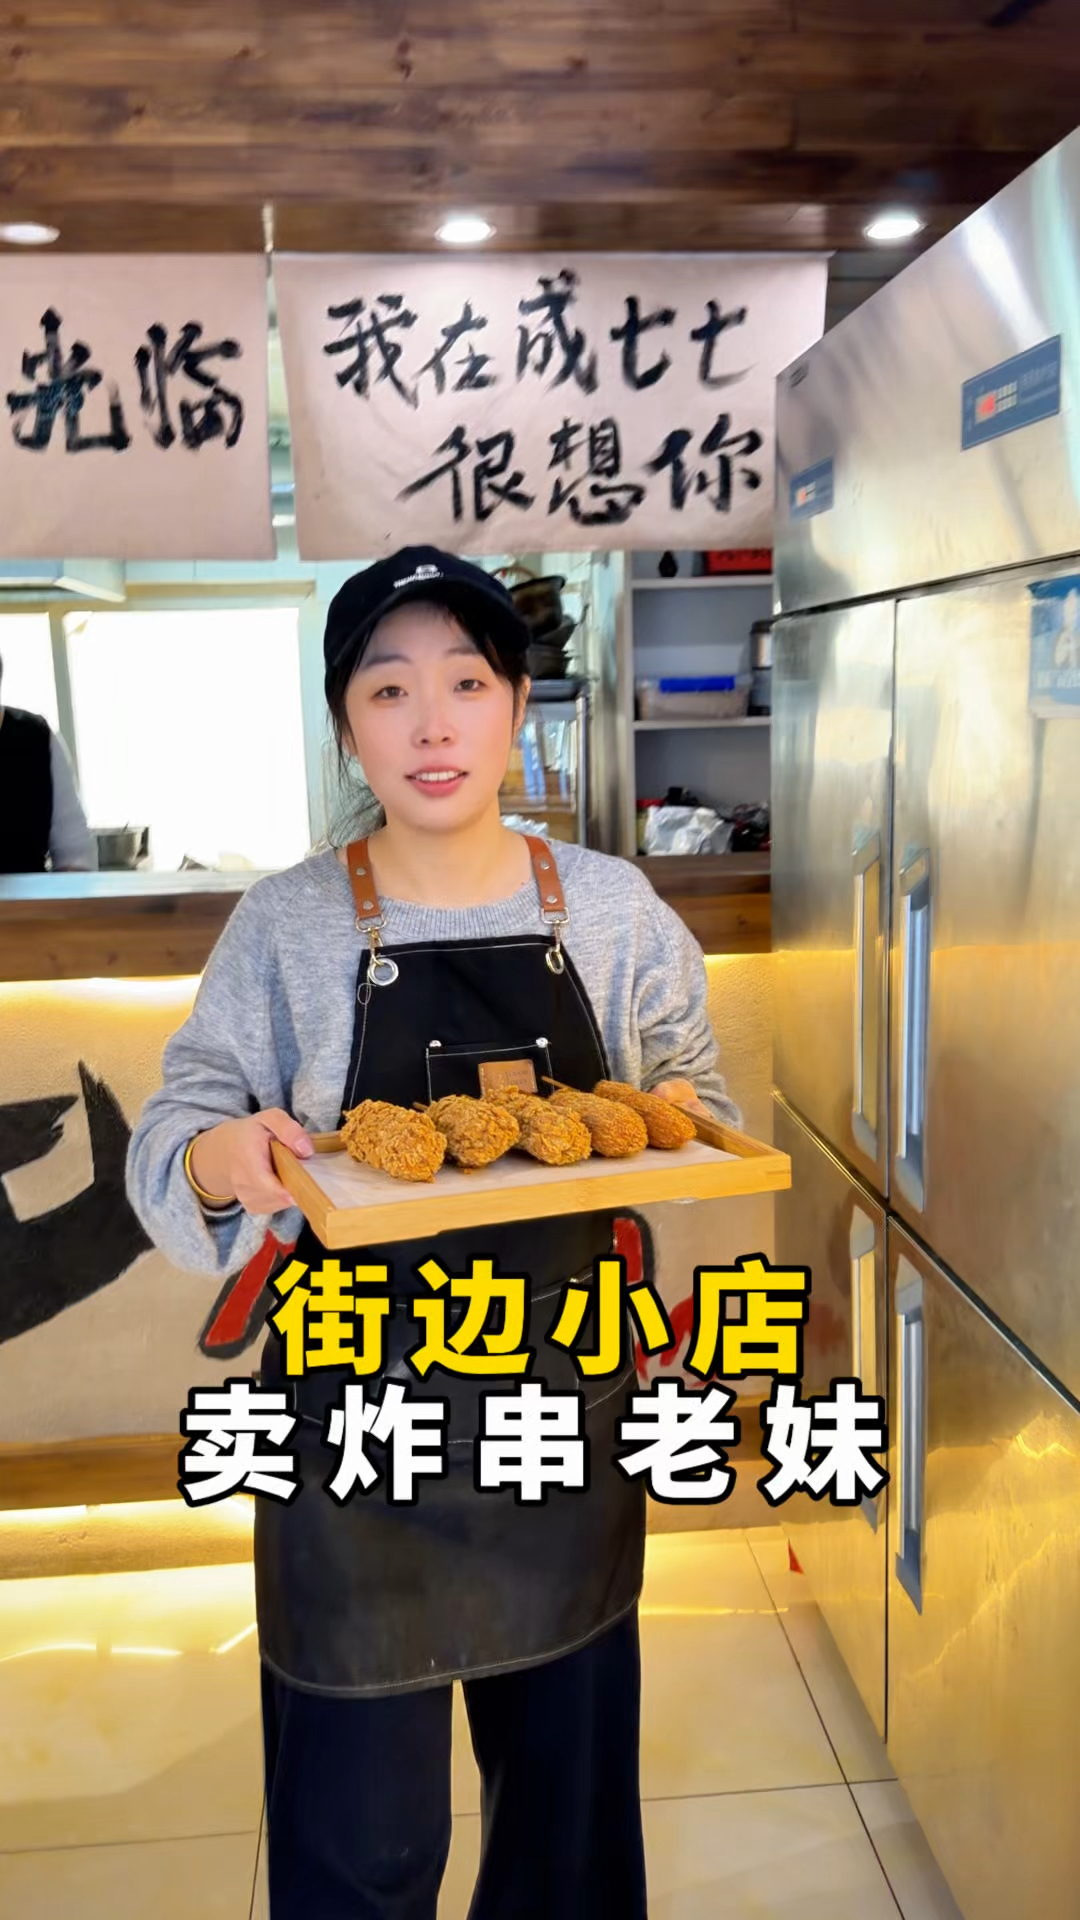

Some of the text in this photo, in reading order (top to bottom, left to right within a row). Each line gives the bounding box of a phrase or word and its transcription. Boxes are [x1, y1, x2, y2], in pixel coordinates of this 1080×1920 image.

[5, 307, 243, 454] 光临
[323, 268, 750, 406] 我在成七七
[398, 413, 764, 527] 很想你
